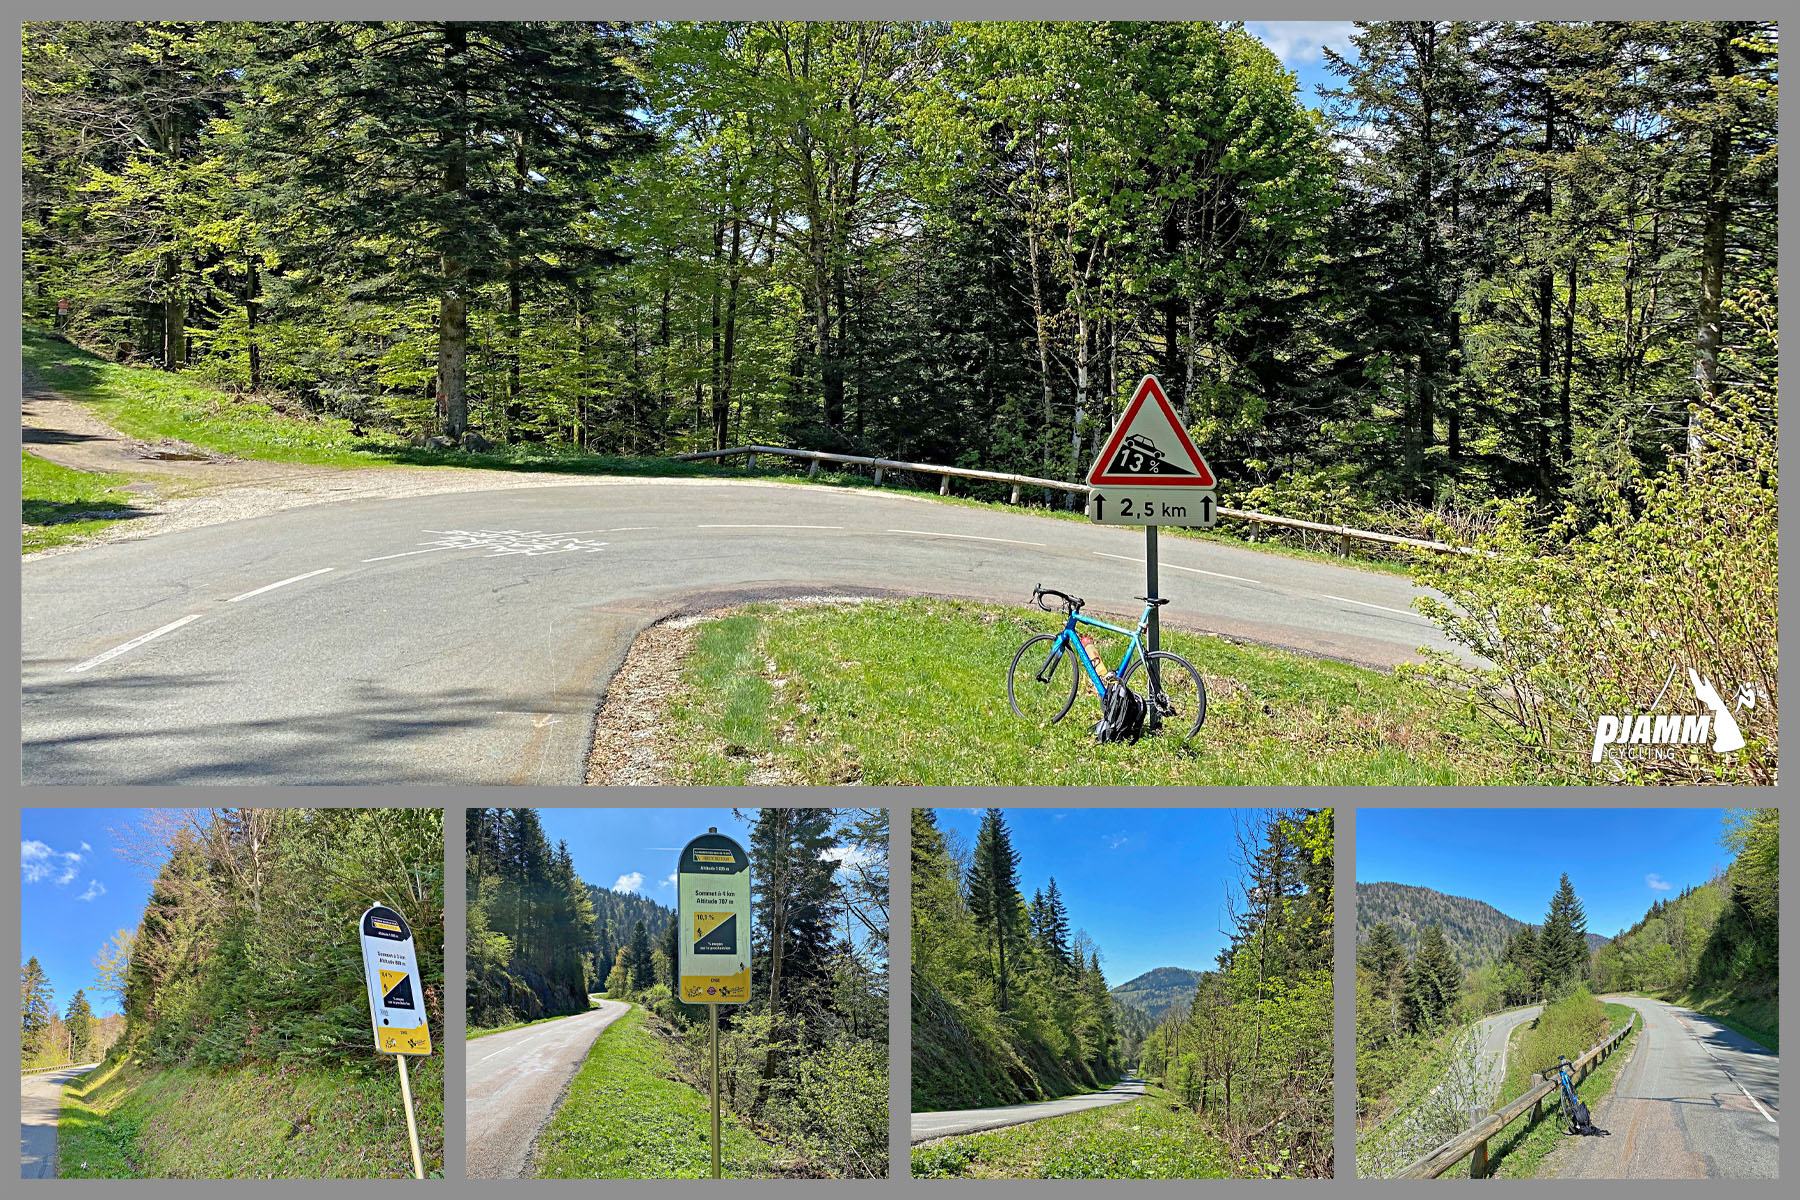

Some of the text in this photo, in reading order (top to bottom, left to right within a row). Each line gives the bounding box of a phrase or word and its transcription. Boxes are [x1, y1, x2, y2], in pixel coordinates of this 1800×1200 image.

[1120, 449, 1160, 474] 13 %
[1120, 498, 1187, 520] 2,5 km
